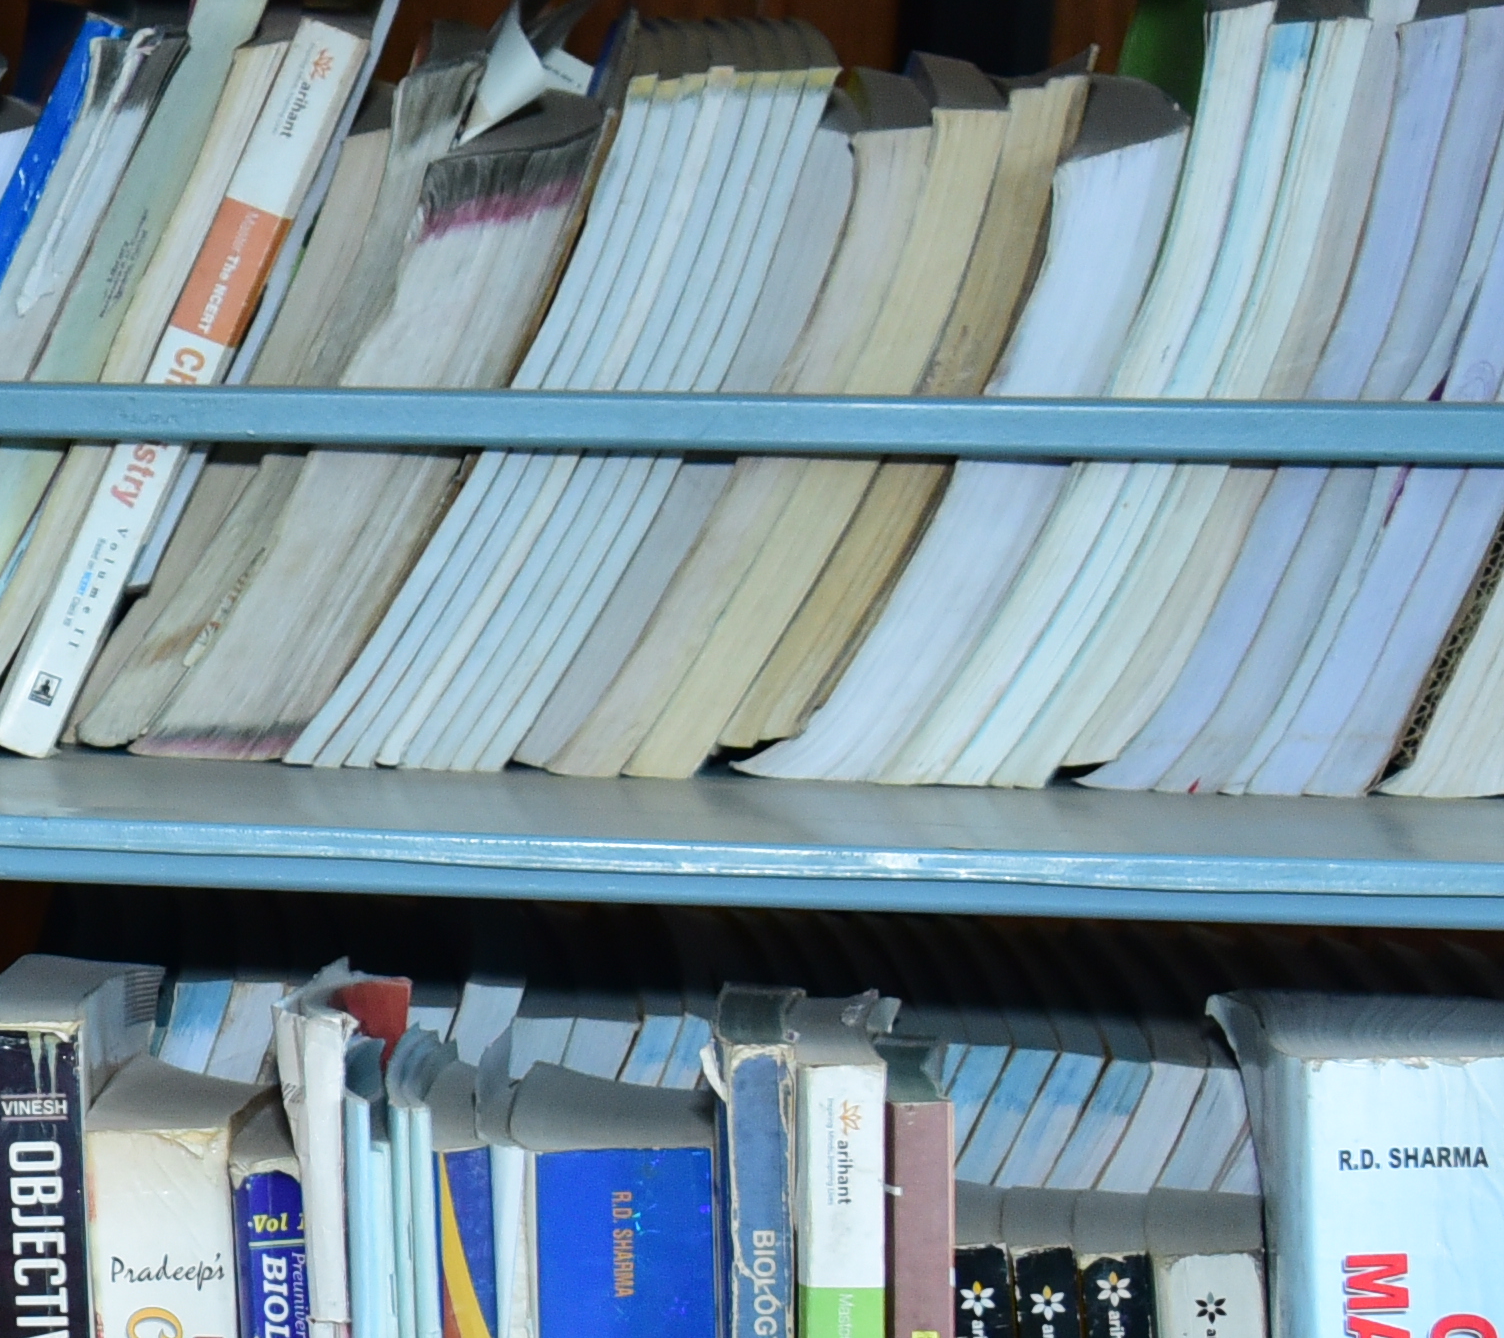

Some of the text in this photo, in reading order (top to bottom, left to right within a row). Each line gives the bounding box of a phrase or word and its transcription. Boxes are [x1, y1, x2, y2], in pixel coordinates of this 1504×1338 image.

[1, 1099, 68, 1116] VINESH
[837, 1140, 853, 1205] arihant
[1339, 1145, 1488, 1171] R.D. SHARMA
[612, 1191, 634, 1298] R.D. SHARMA
[110, 1253, 225, 1290] Pradeep's
